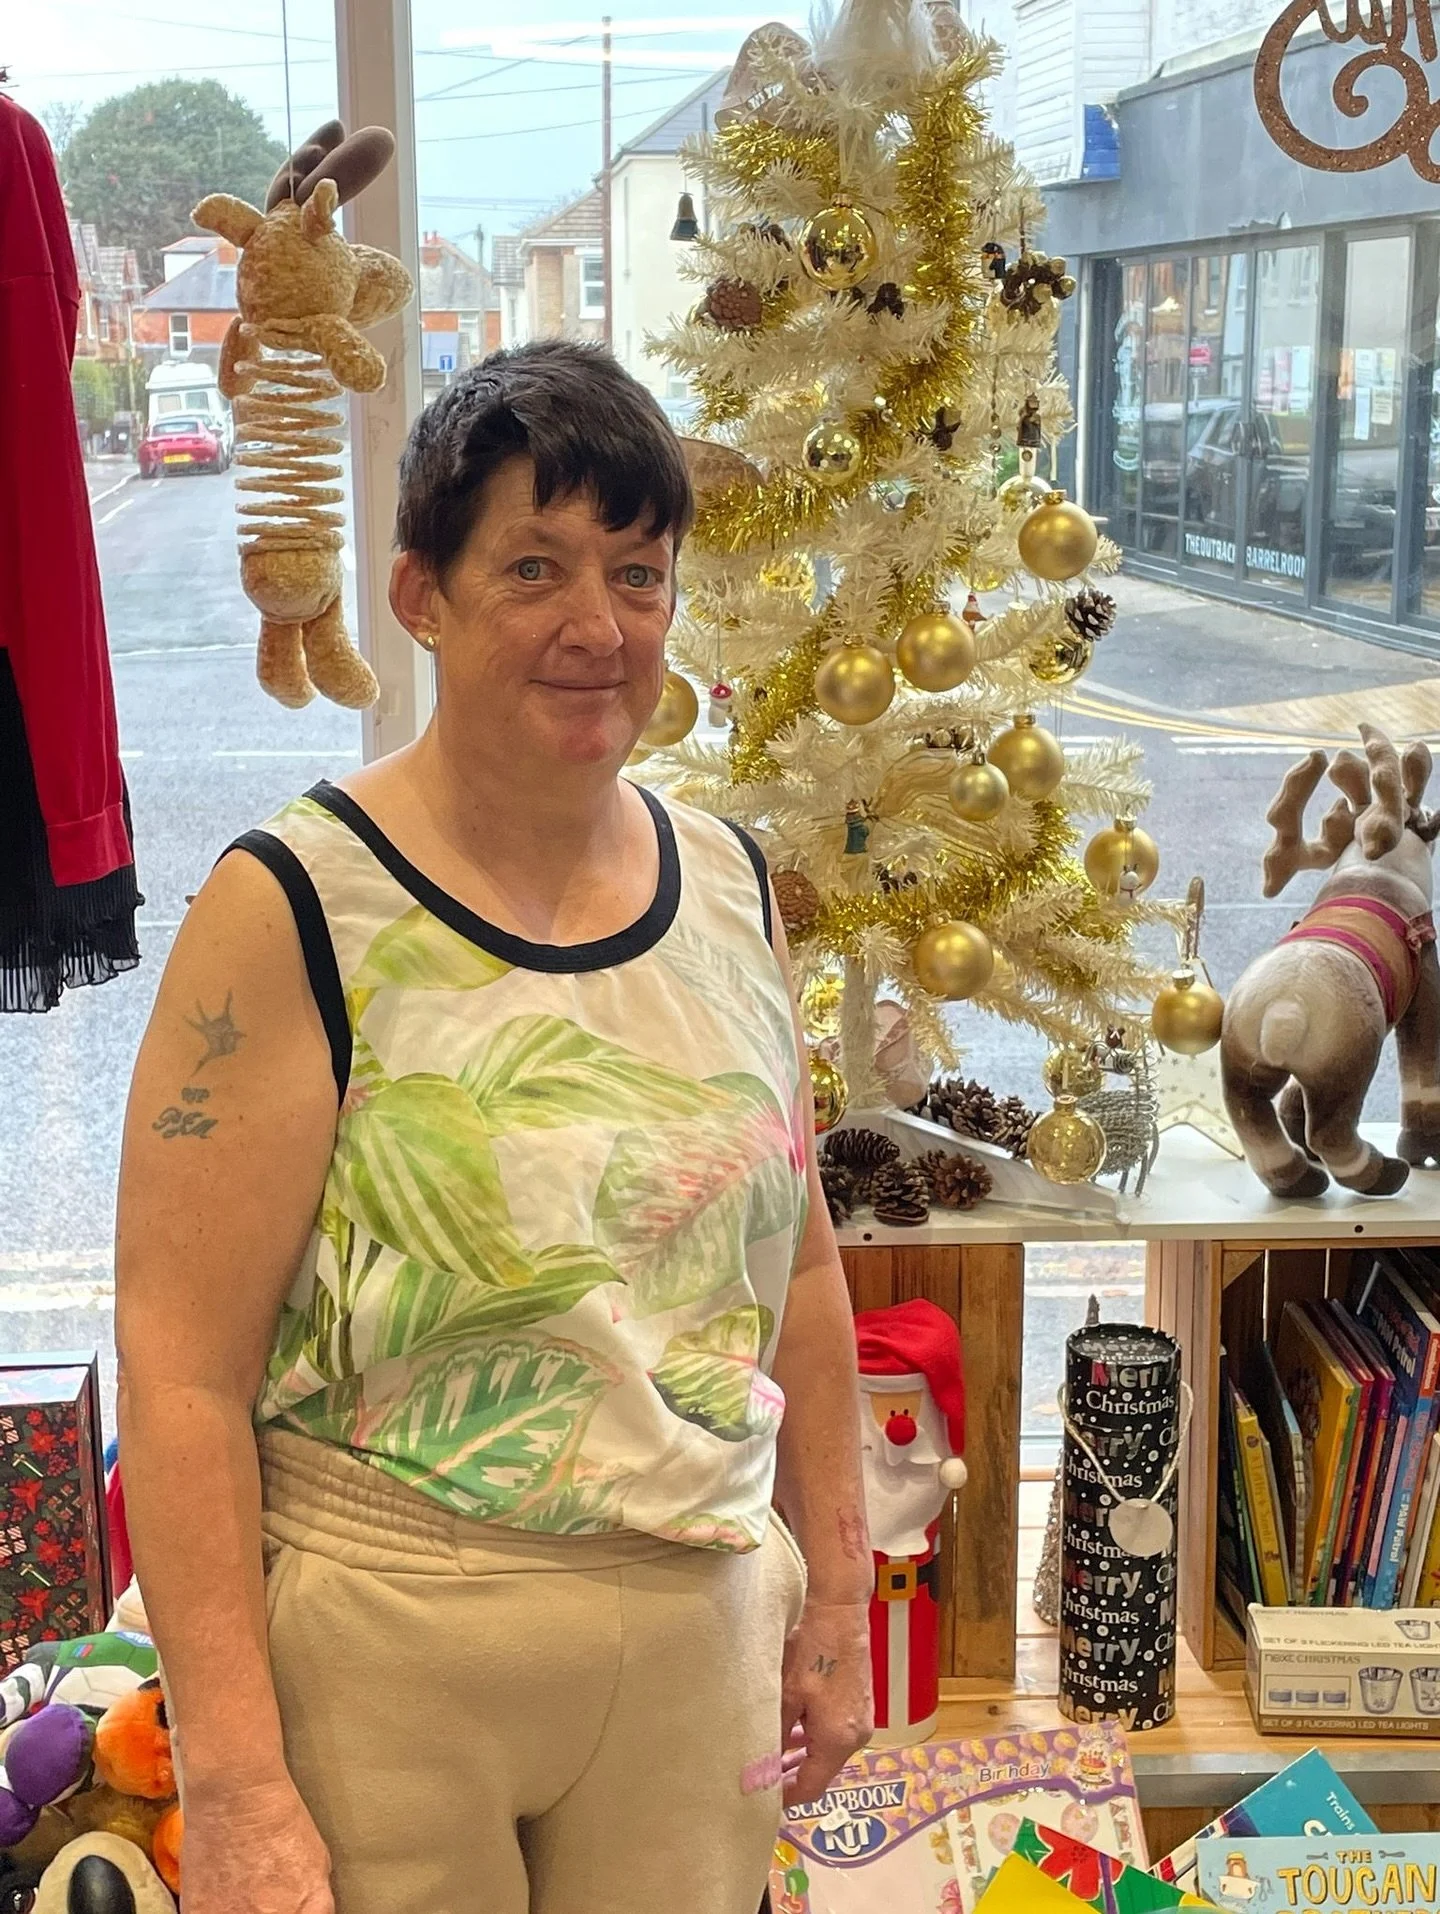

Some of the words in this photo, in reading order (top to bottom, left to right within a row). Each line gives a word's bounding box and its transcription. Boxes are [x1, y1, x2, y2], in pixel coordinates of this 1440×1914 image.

[1086, 1390, 1174, 1415] Christmas
[1080, 1431, 1144, 1460] erry
[1066, 1455, 1143, 1488] hristmas
[1064, 1526, 1132, 1558] hristm
[1064, 1591, 1140, 1624] hristmas
[1296, 1655, 1361, 1664] CHRISTMAS
[1062, 1660, 1138, 1692] hristmas
[1325, 1792, 1356, 1831] Trains
[1335, 1850, 1372, 1863] THE
[1276, 1863, 1437, 1906] TOUCAN
